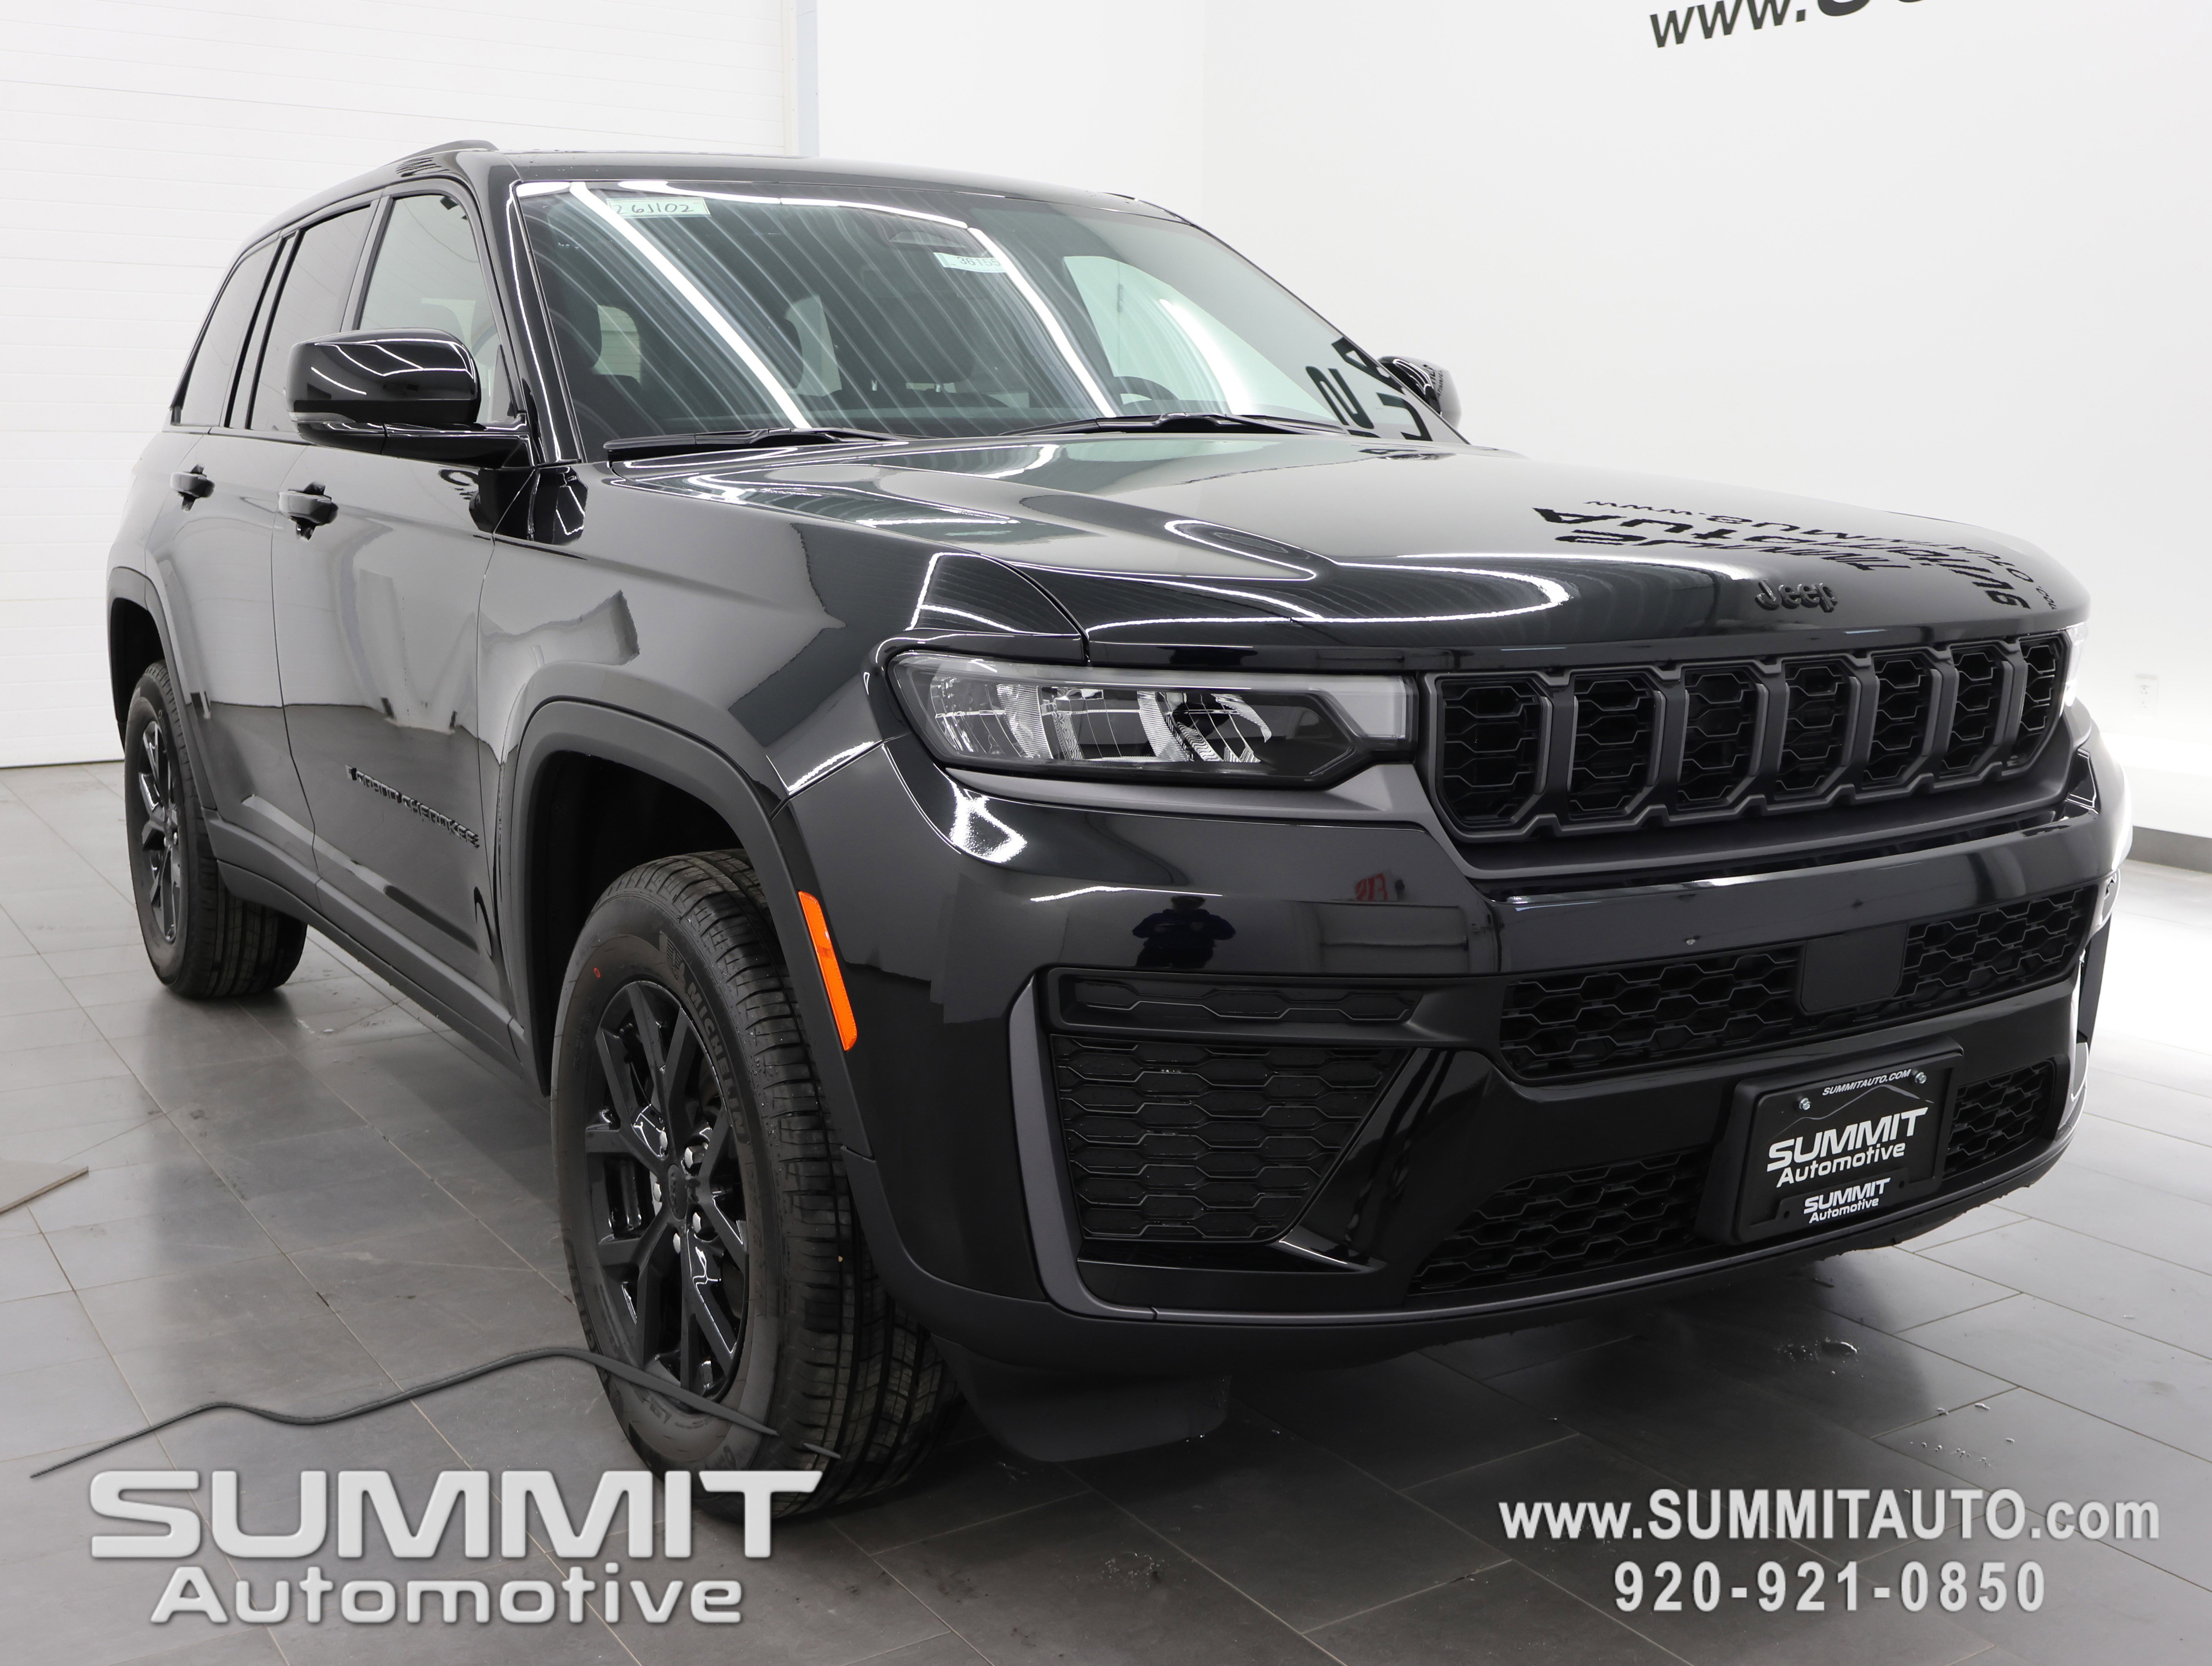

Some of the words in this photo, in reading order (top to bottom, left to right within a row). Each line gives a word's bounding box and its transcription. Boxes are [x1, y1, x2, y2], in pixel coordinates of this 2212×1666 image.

[1755, 579, 1838, 613] Jeep
[1822, 1069, 1911, 1096] SUMMITAUTO.COM
[1767, 1107, 1928, 1172] SUMMIT
[1776, 1142, 1906, 1188] Automotive
[1804, 1177, 1891, 1214] SUMMIT
[1808, 1197, 1879, 1224] Automotive
